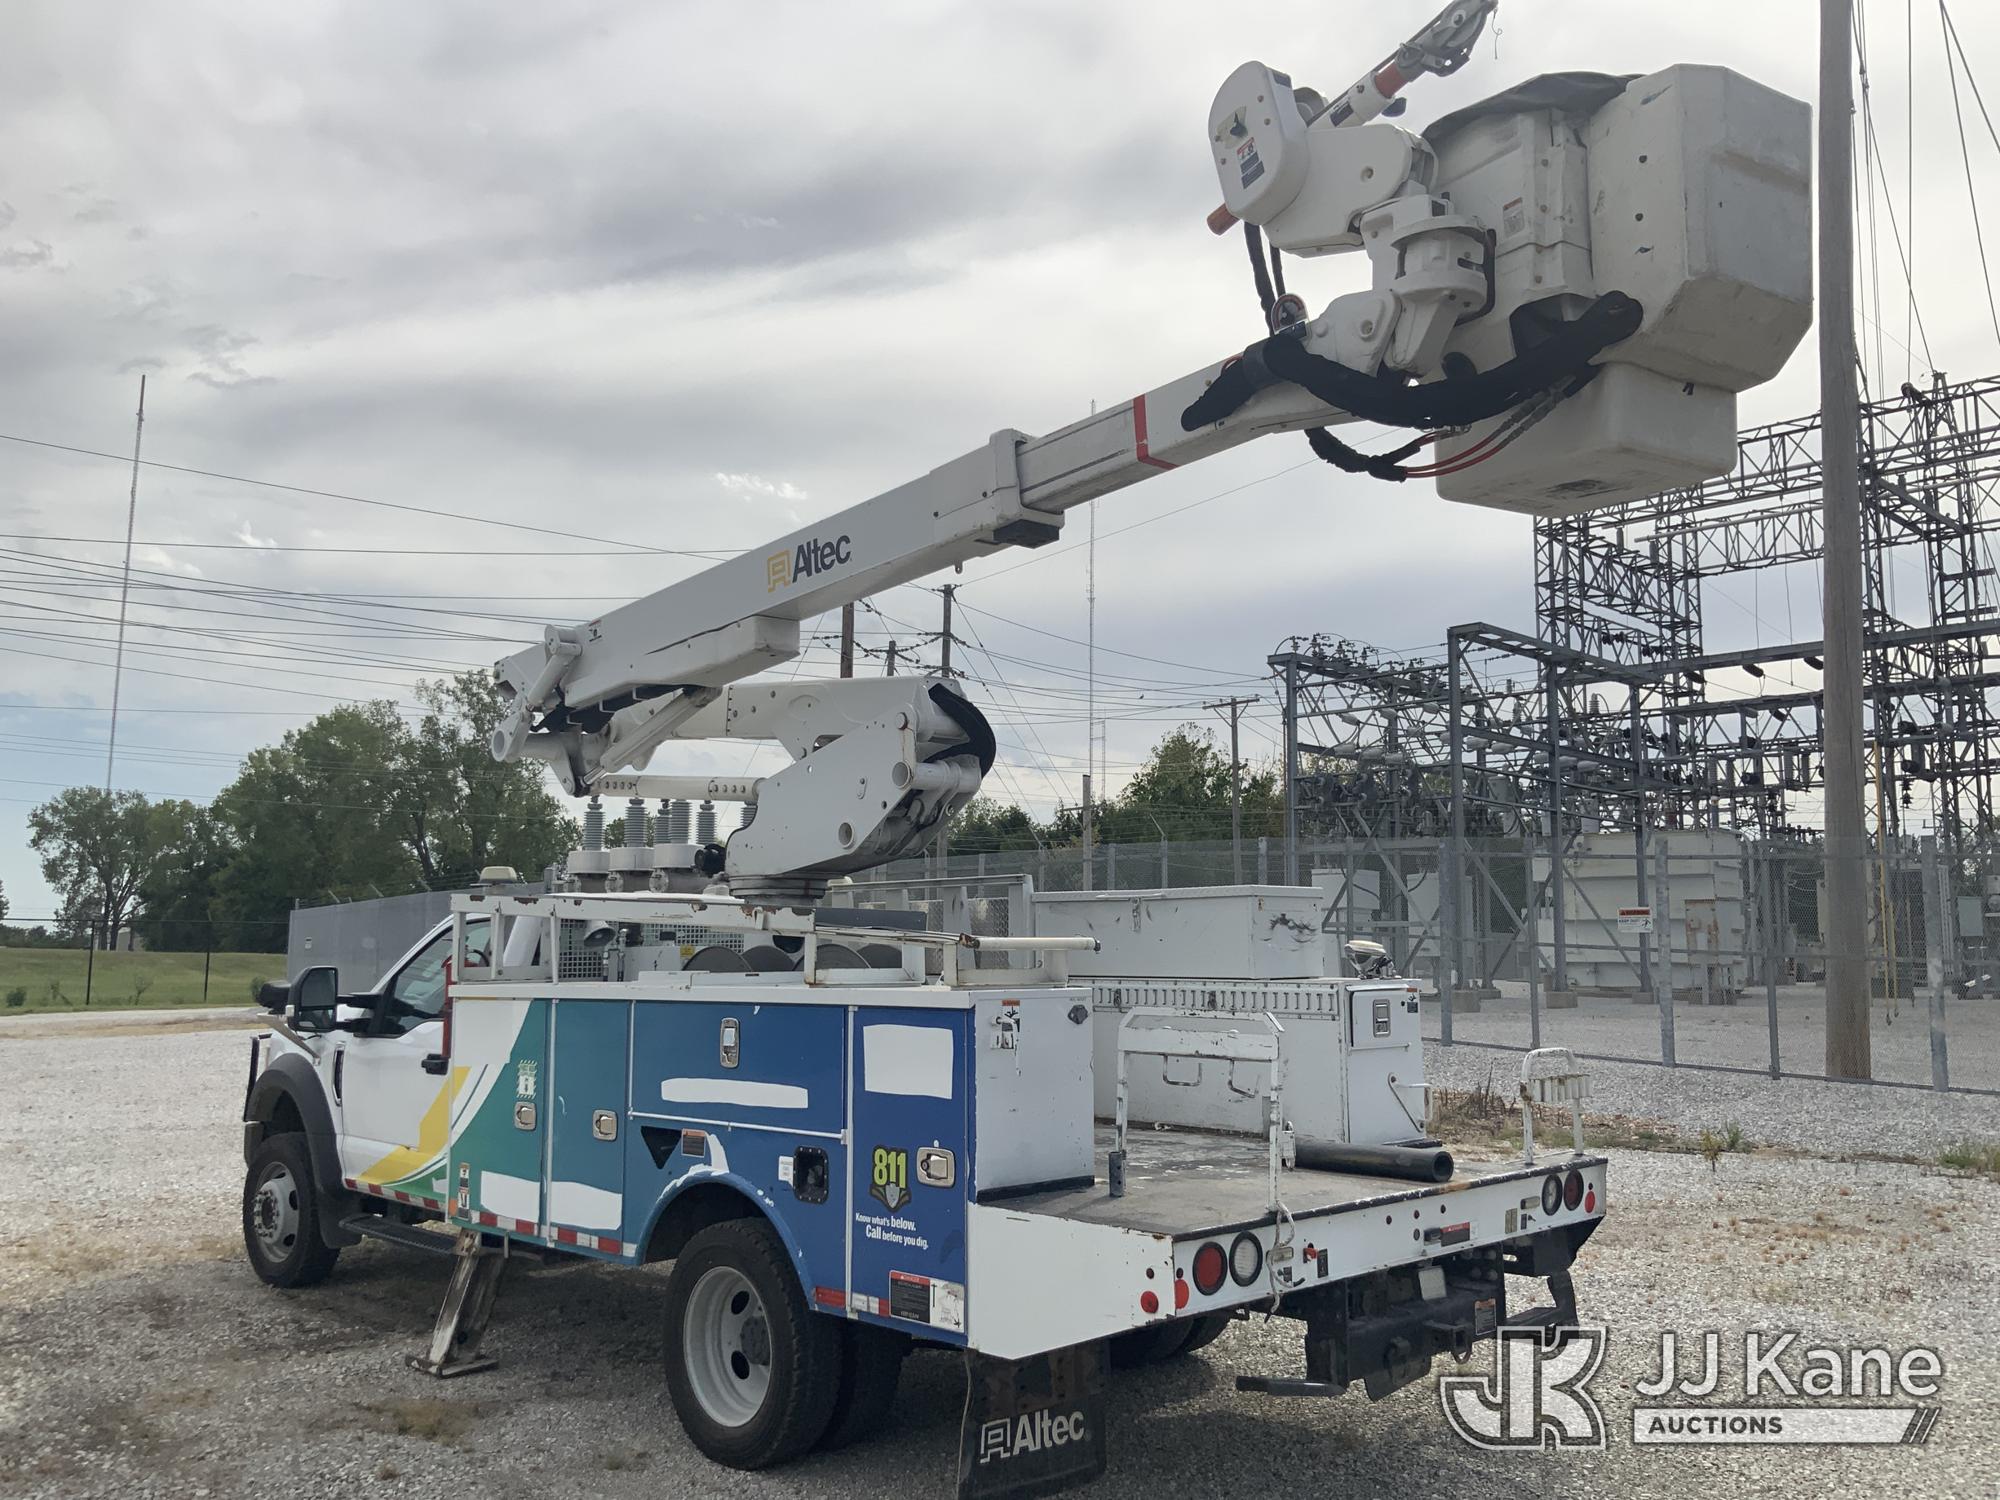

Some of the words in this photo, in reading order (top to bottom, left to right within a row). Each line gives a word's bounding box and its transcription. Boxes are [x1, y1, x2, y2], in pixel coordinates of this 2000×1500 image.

[792, 535, 851, 583] Altec
[873, 1148, 906, 1189] 811
[855, 1212, 871, 1223] Know
[871, 1215, 890, 1227] what's
[890, 1215, 916, 1232] below.
[865, 1224, 882, 1240] Call
[882, 1230, 903, 1244] before
[903, 1235, 916, 1247] you
[916, 1236, 929, 1251] dig.
[1012, 1409, 1085, 1456] Altec
